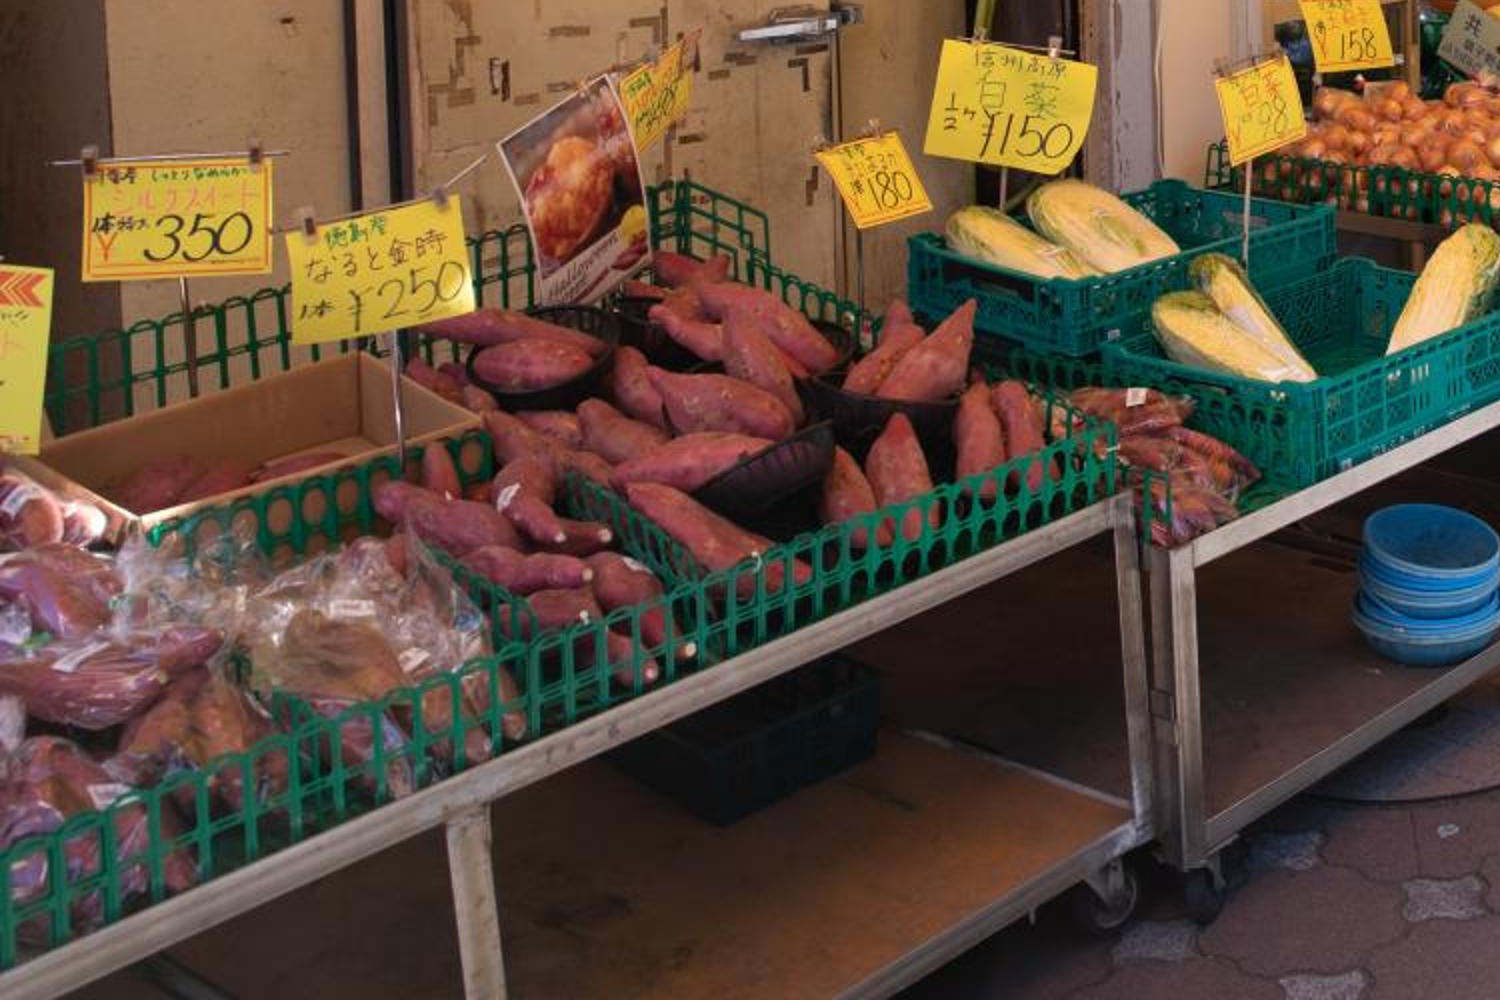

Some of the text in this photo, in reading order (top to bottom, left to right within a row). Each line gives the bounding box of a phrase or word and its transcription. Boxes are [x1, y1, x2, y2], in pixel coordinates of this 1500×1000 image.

[1340, 27, 1378, 61] 158
[979, 69, 1060, 121] 白菜
[867, 170, 913, 211] 180
[143, 210, 253, 263] 350
[305, 228, 448, 284] なると金時
